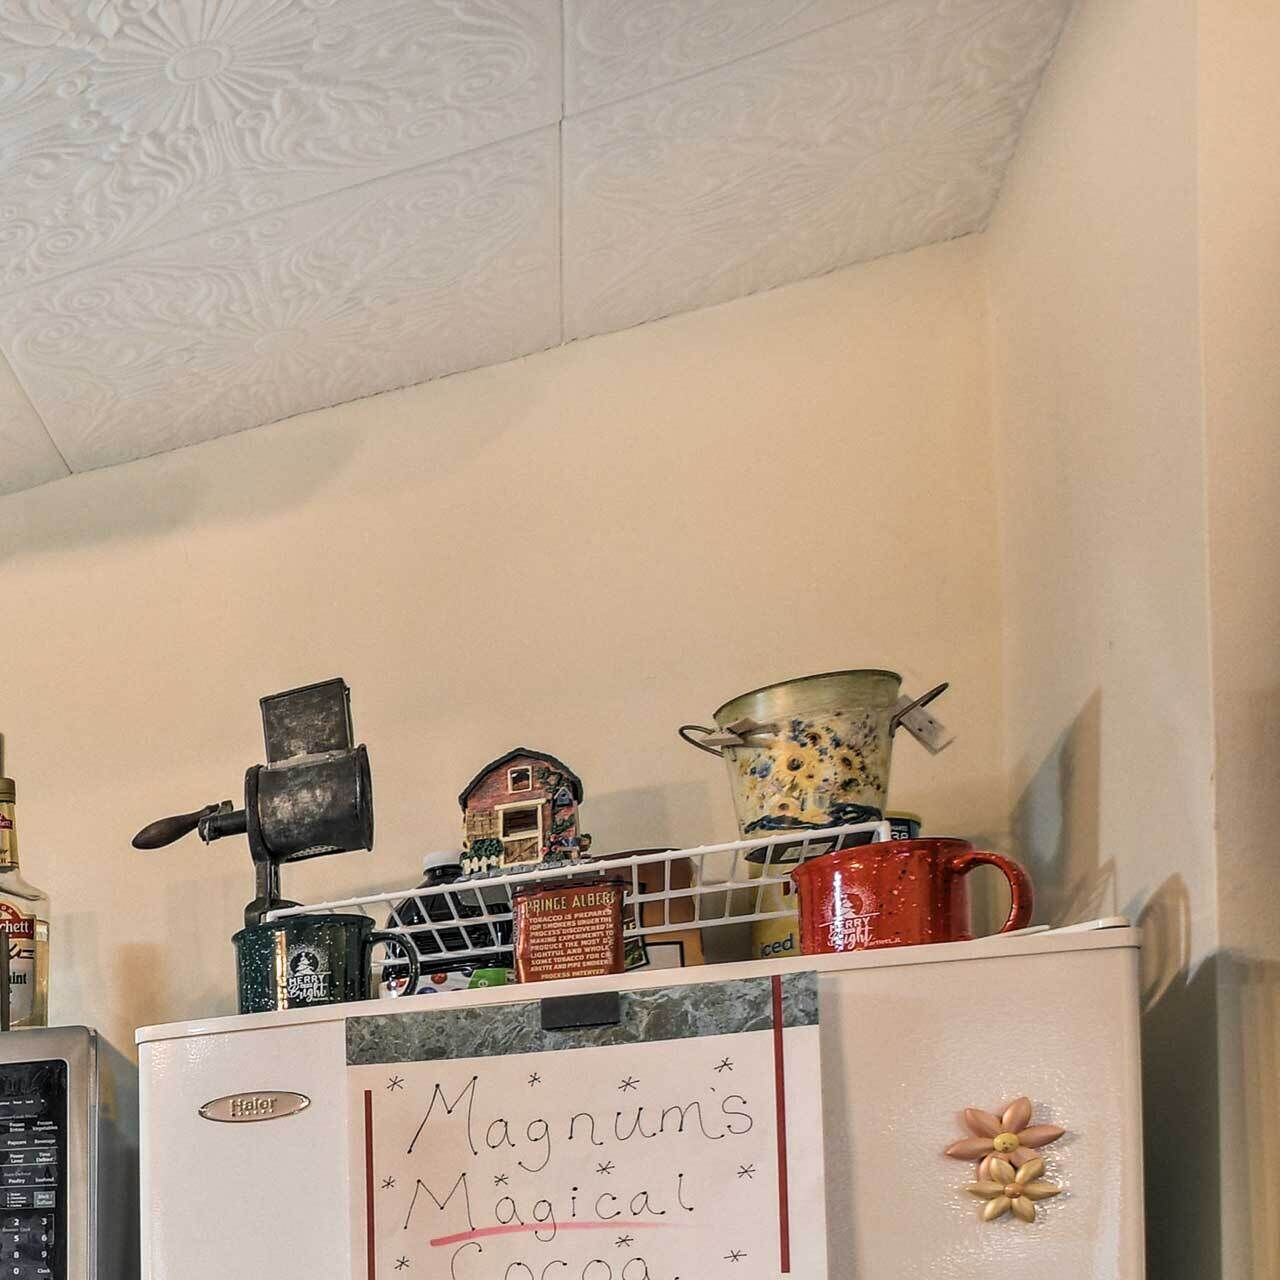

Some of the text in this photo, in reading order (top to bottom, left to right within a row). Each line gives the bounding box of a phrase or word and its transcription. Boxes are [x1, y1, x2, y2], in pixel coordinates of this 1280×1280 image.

[525, 895, 567, 914] PRINCE
[407, 1075, 754, 1173] Magnum's
[403, 1172, 695, 1243] Magical
[13, 1218, 20, 1226] 2
[41, 1217, 48, 1226] 3
[41, 1234, 48, 1242] 6
[13, 1251, 20, 1259] 8
[41, 1250, 47, 1258] 9
[13, 1267, 20, 1275] 0
